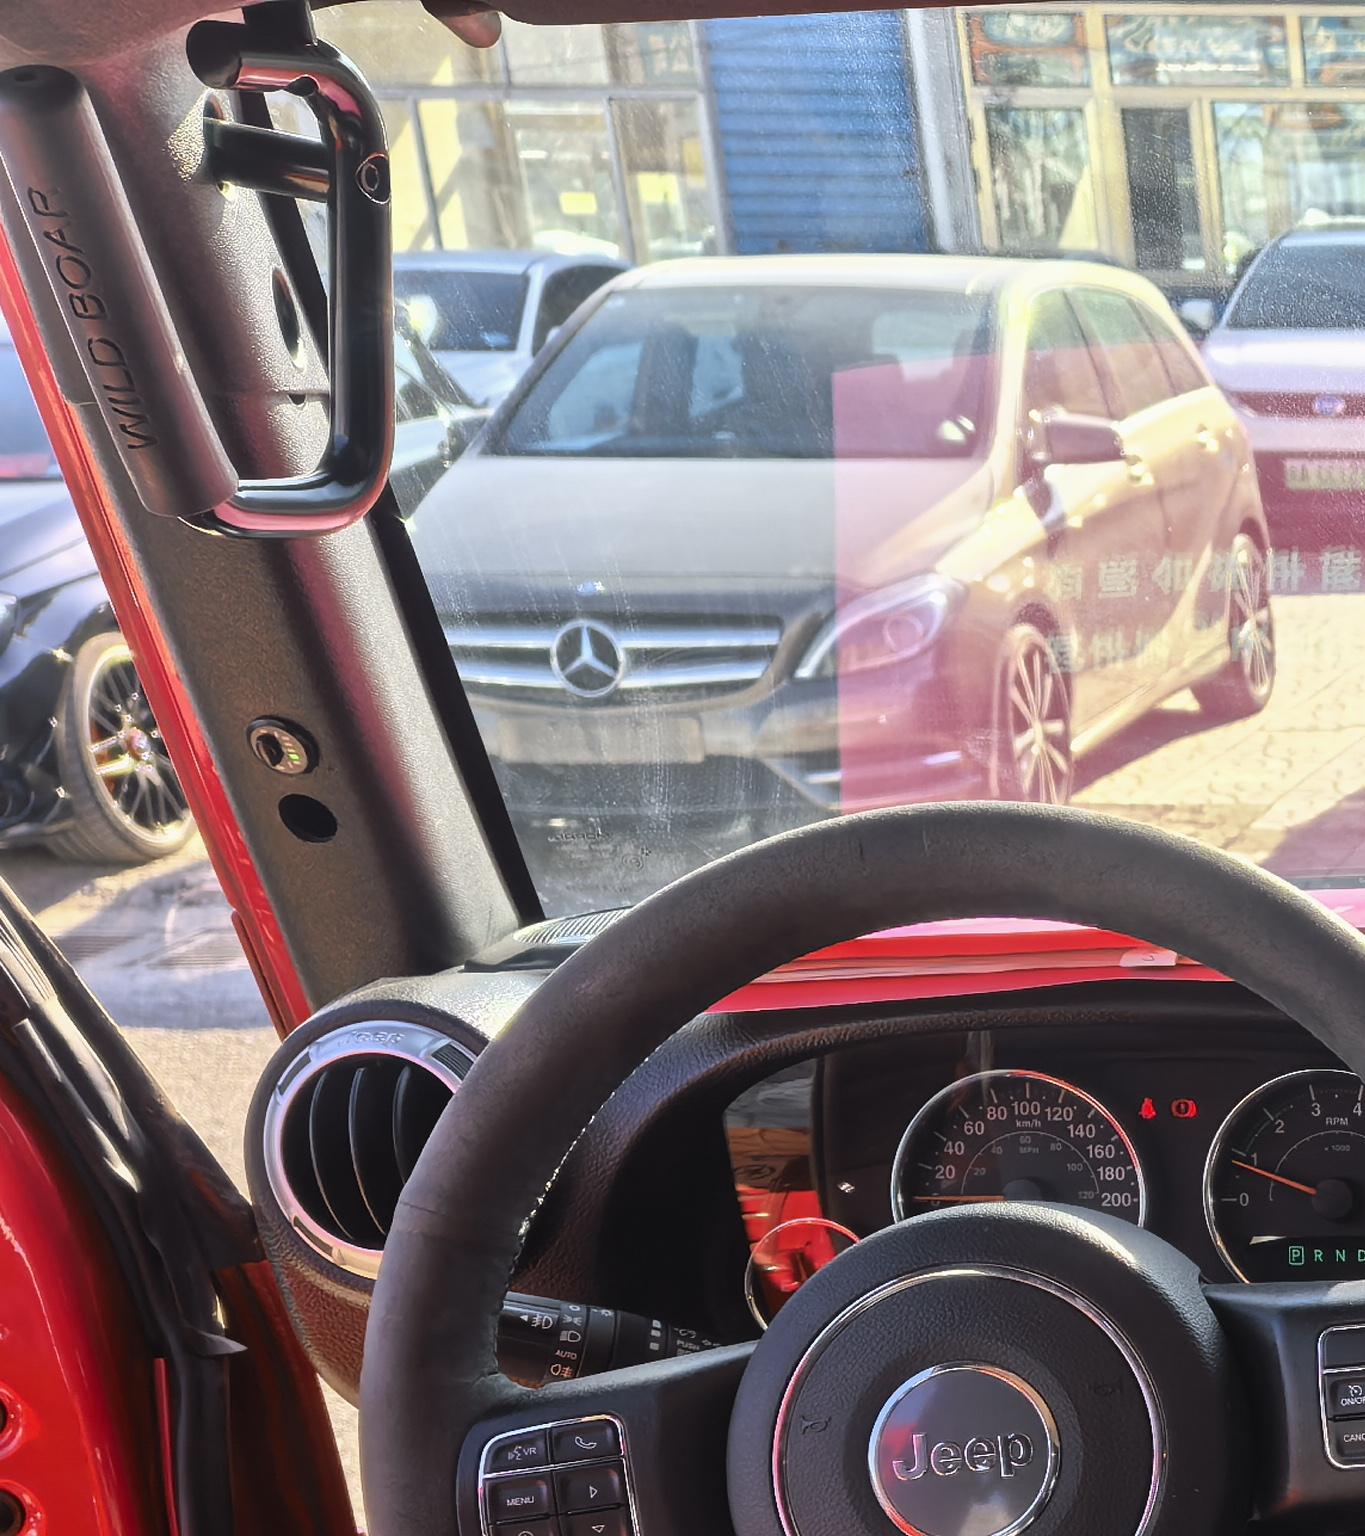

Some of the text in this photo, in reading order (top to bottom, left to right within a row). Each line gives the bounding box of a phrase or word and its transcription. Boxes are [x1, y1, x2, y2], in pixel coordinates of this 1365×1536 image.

[27, 185, 158, 450] WILD BOAR
[986, 1106, 1007, 1121] 80
[1011, 1101, 1041, 1116] 100
[1045, 1106, 1073, 1121] 120
[1311, 1103, 1322, 1116] 3
[1352, 1103, 1363, 1116] 4
[963, 1121, 985, 1136] 60
[1016, 1119, 1041, 1128] km/h
[1274, 1120, 1285, 1134] 2
[1325, 1117, 1349, 1126] RPM
[1067, 1124, 1096, 1139] 140
[944, 1140, 965, 1156] 40
[1087, 1144, 1115, 1159] 160
[1250, 1153, 1258, 1166] 1
[935, 1164, 956, 1179] 20
[1097, 1166, 1125, 1181] 180
[1101, 1192, 1131, 1207] 200
[1239, 1193, 1250, 1206] 0
[1292, 1251, 1301, 1262] P
[1314, 1250, 1324, 1262] R
[1336, 1250, 1346, 1262] N
[555, 1349, 578, 1361] AUTO
[523, 1447, 537, 1456] VR
[892, 1432, 1034, 1481] Jeep
[506, 1496, 535, 1507] MENU
